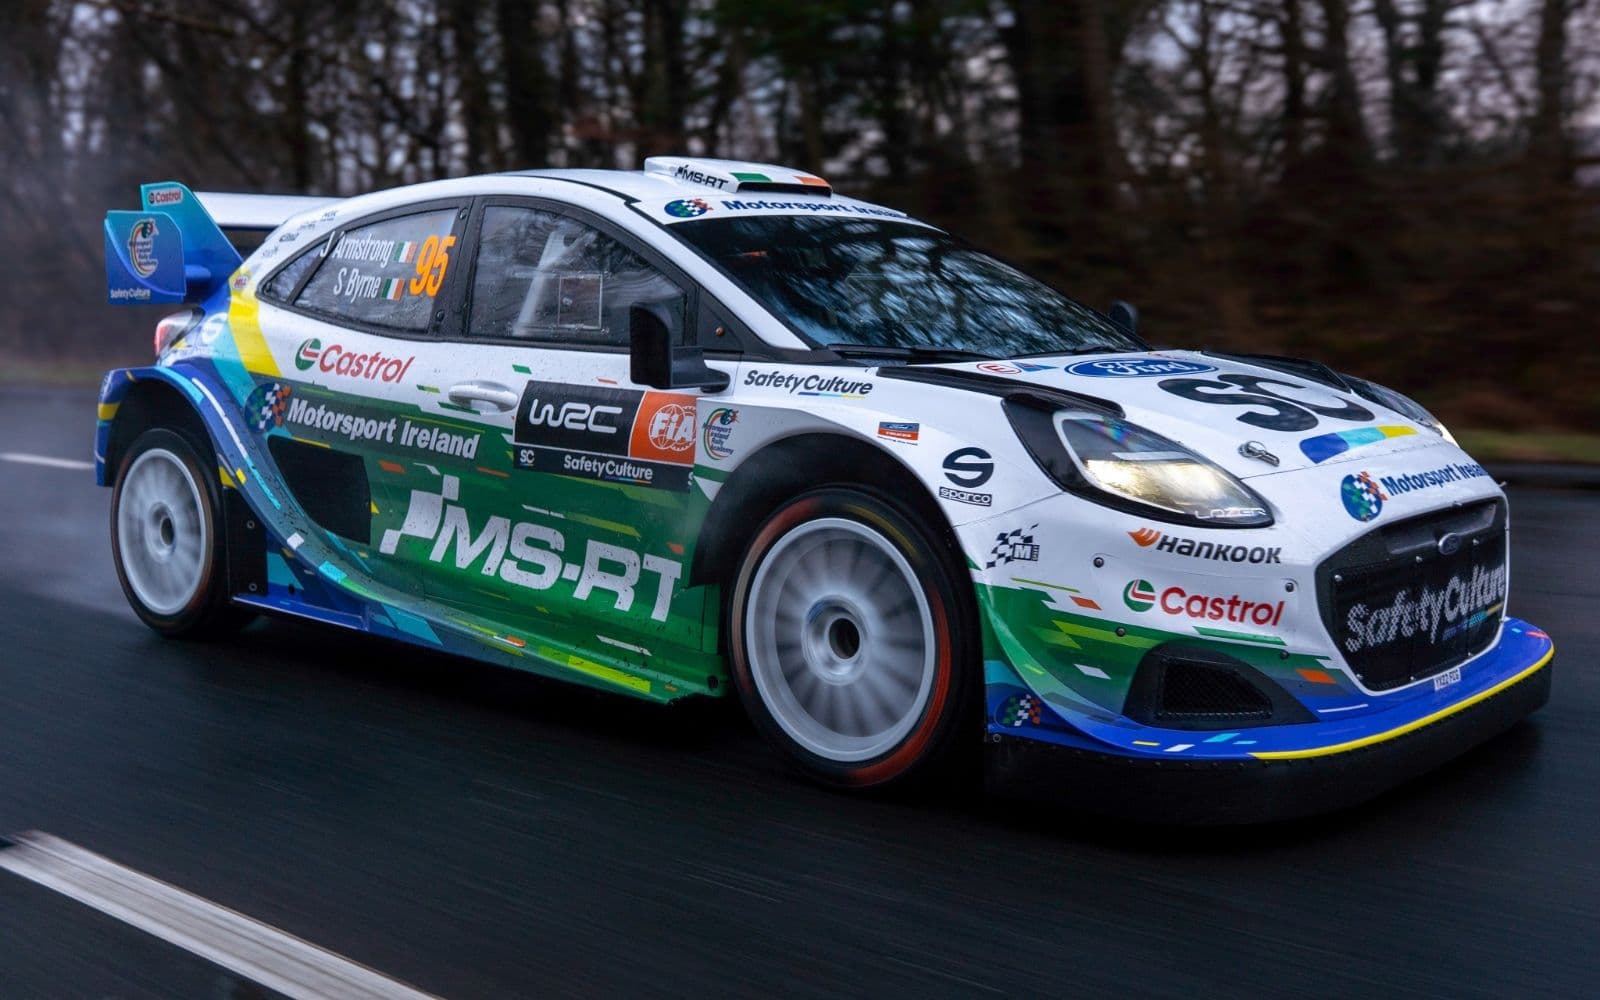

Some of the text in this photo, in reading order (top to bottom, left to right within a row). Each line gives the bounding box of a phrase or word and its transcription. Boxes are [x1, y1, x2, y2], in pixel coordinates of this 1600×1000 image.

[155, 190, 181, 203] Castrol
[721, 200, 851, 212] Motorsport
[320, 230, 394, 268] J Armstrong
[409, 234, 457, 297] 95
[110, 288, 151, 299] SafetyCulture
[333, 267, 382, 303] S Byrne
[319, 344, 415, 384] Castrol
[1092, 360, 1199, 375] Ford
[744, 370, 873, 394] SafetyCulture
[529, 398, 623, 434] WRC
[1158, 374, 1376, 432] SC
[287, 398, 480, 459] Motorsport Ireland
[520, 449, 534, 464] SC
[563, 454, 653, 481] SafetyCulture
[940, 487, 991, 504] sparco
[1380, 465, 1461, 496] Motorsport
[1160, 586, 1285, 626] Castrol
